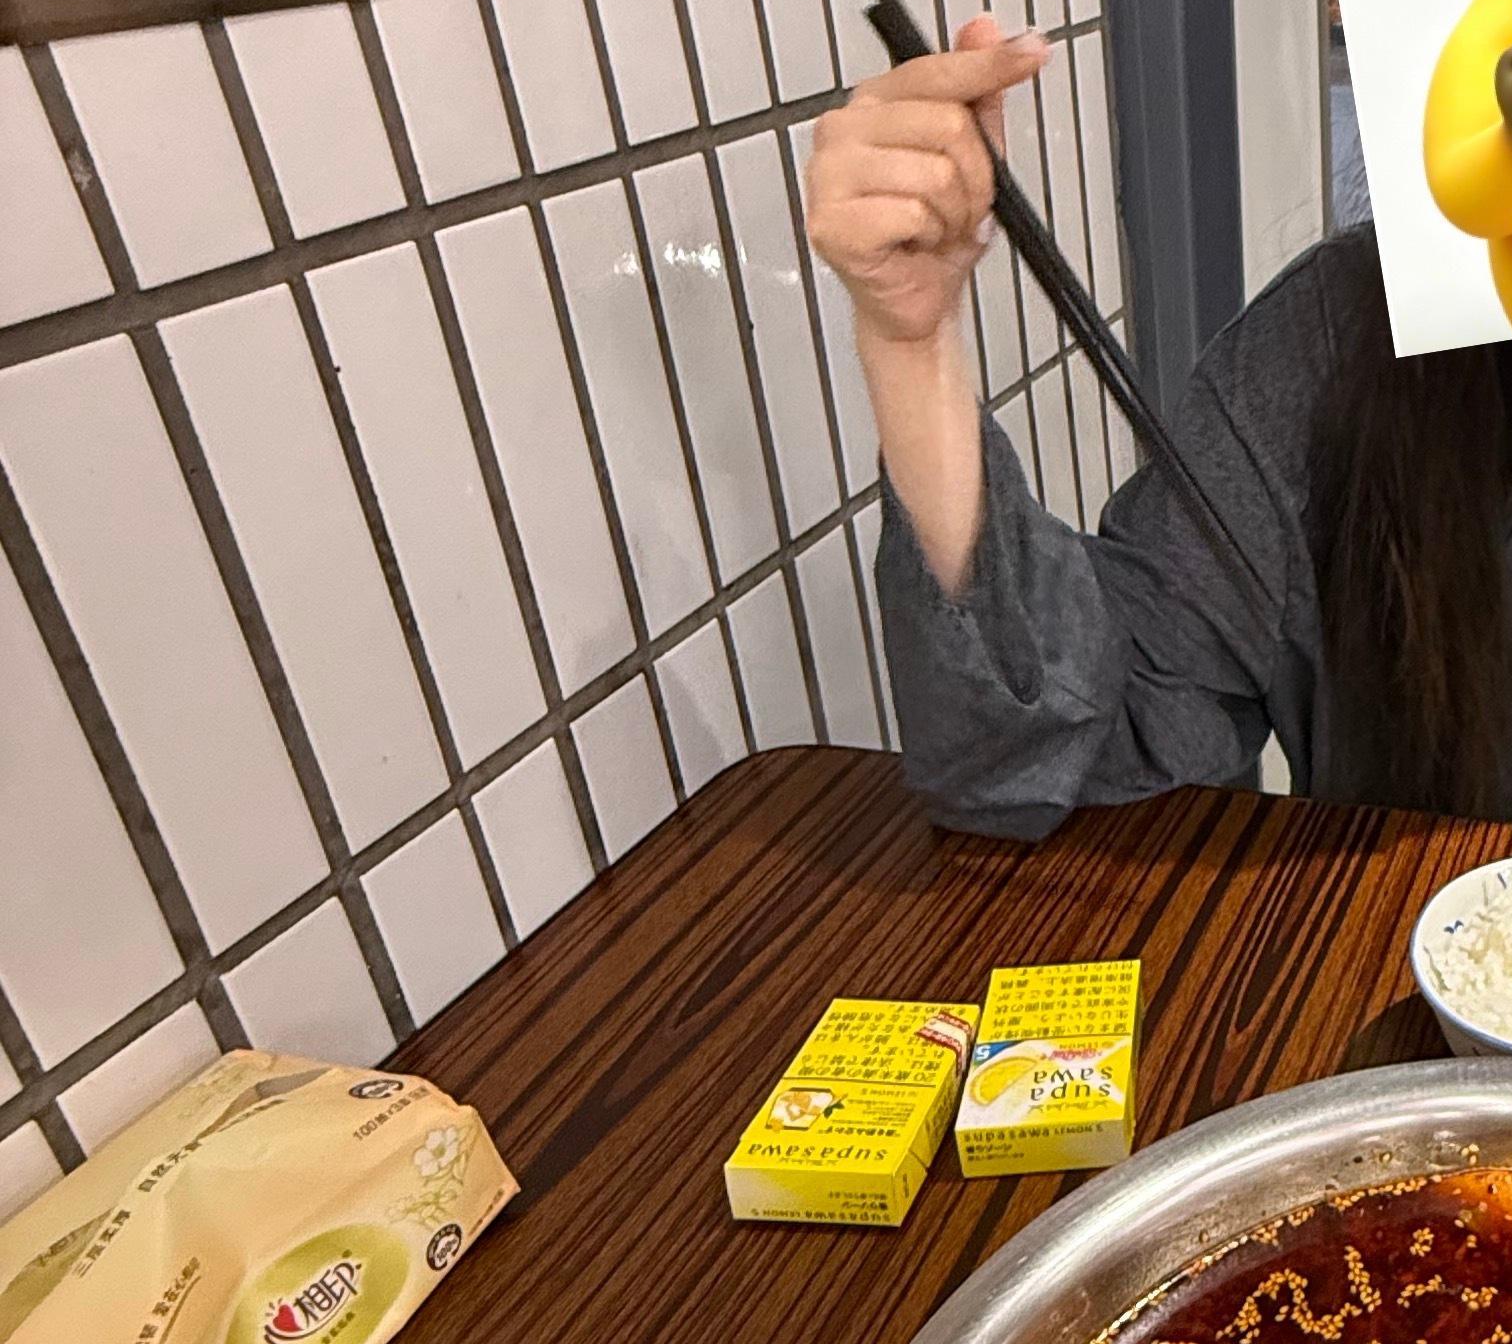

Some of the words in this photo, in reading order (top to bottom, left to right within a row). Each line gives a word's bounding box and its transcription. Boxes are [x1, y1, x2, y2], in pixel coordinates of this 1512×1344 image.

[976, 1045, 991, 1059] 5
[1033, 1066, 1114, 1084] sawa
[1030, 1082, 1112, 1101] supa
[747, 1143, 889, 1161] supasawa
